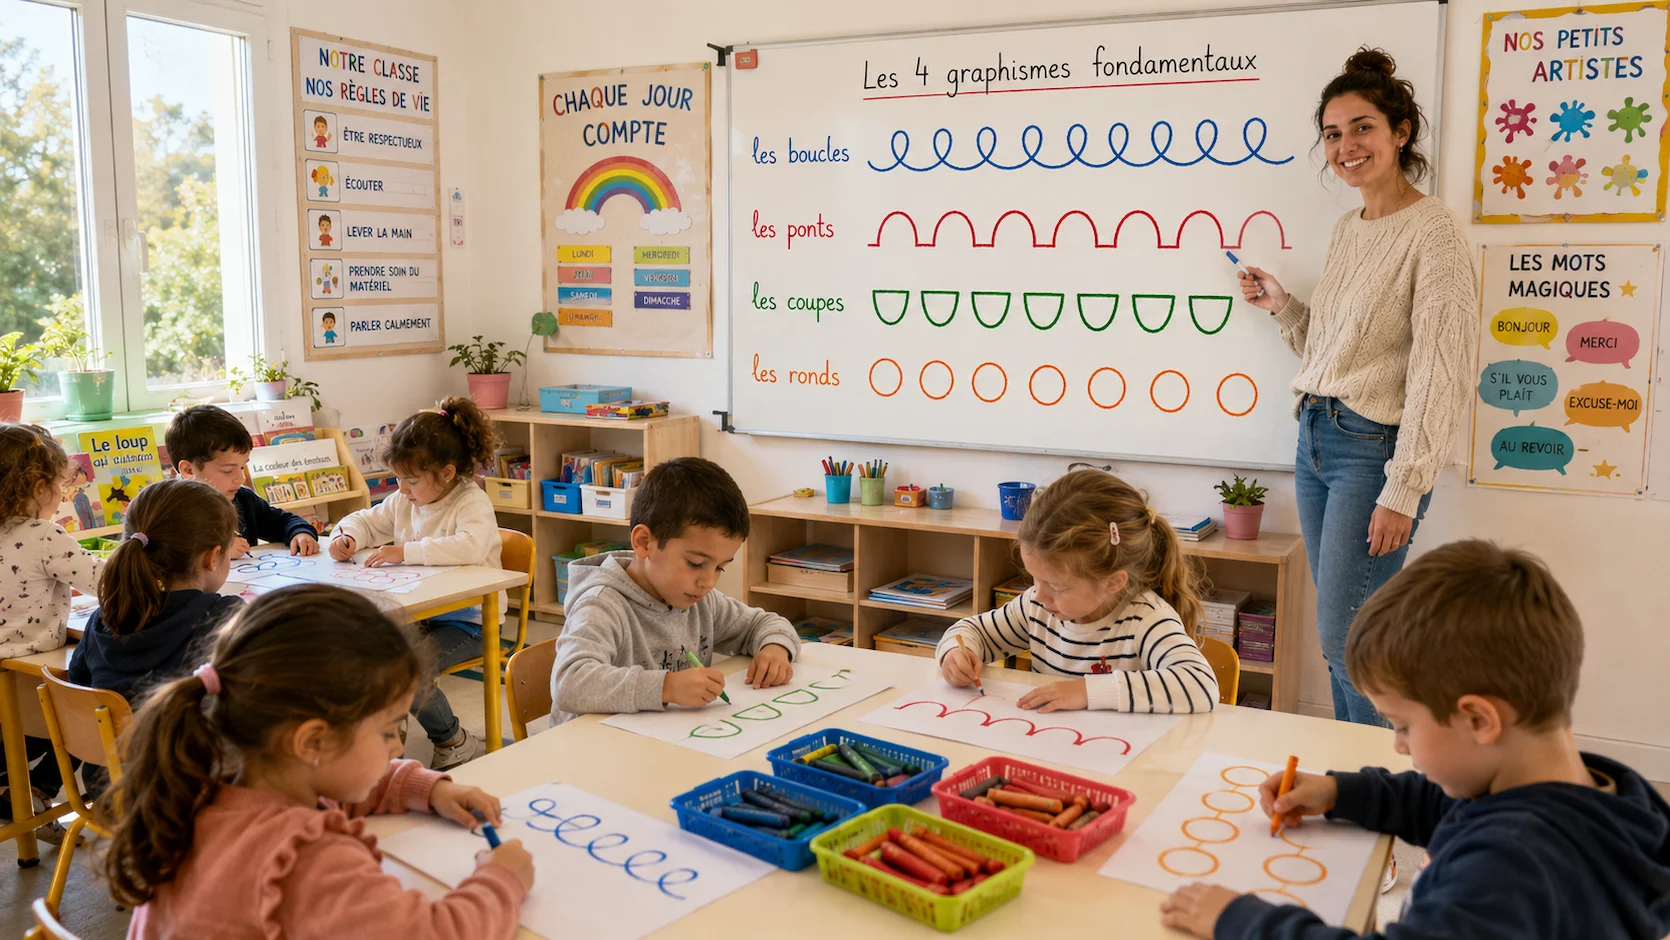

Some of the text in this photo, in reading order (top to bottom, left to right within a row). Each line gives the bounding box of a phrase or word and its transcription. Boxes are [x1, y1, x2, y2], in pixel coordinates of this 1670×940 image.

[1504, 31, 1544, 52] NOS
[319, 47, 420, 83] NOTRE CLASSE
[863, 43, 1257, 98] Les 4 graphismes fondamentaux
[305, 77, 334, 98] NOS
[340, 79, 386, 106] RÈGLES
[392, 91, 407, 109] DE
[553, 84, 693, 116] CHAQUE JOUR
[368, 132, 423, 149] RESPECTUEUX
[583, 120, 668, 147] COMPTE
[752, 135, 850, 165] les boucles
[345, 175, 384, 192] ÉCOUTER
[347, 226, 412, 239] LEVER LA MAIN
[751, 209, 835, 250] les ponts
[572, 249, 594, 258] LUNDI
[349, 265, 420, 277] PRENDRE SOIN DU
[1509, 254, 1606, 272] LES MOTS
[350, 279, 392, 292] MATÉRIEL
[1508, 280, 1611, 299] MAGIQUES
[752, 281, 845, 323] les coupes
[350, 318, 432, 332] PARLER CALMEMENT
[1497, 320, 1551, 333] BONJOUR
[1580, 336, 1618, 349] MERCI
[752, 353, 841, 387] les ronds
[1490, 372, 1548, 386] S'IL VOUS
[1568, 396, 1639, 411] EXCUSE-MOI
[91, 434, 148, 453] Le loup
[1499, 440, 1565, 455] AU REVOIR
